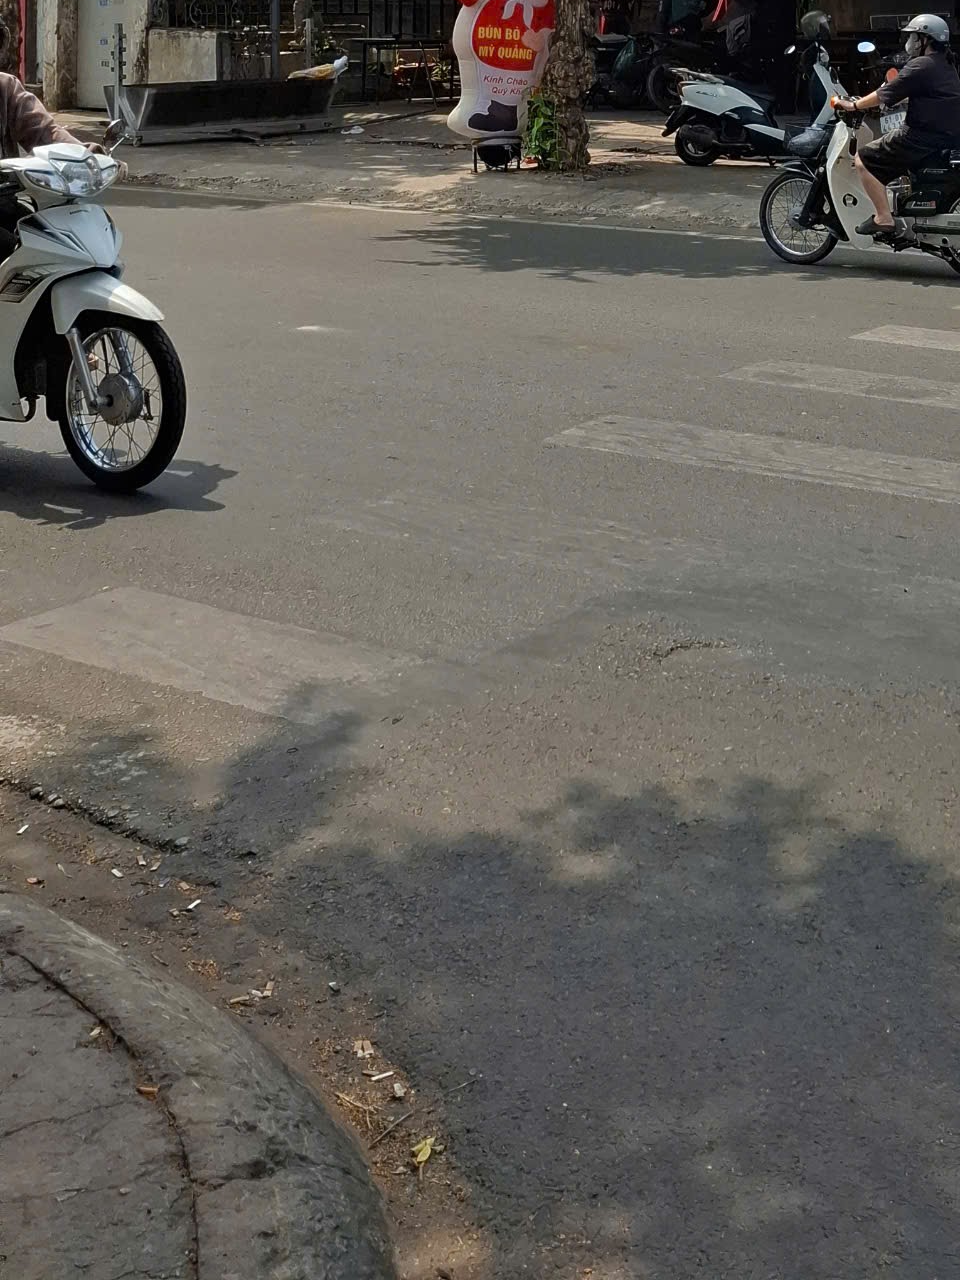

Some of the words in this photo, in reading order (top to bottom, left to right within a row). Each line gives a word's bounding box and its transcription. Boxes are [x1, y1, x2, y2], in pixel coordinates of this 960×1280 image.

[478, 24, 502, 39] BÚN
[505, 26, 520, 40] BÒ
[497, 44, 533, 60] QUẢNG
